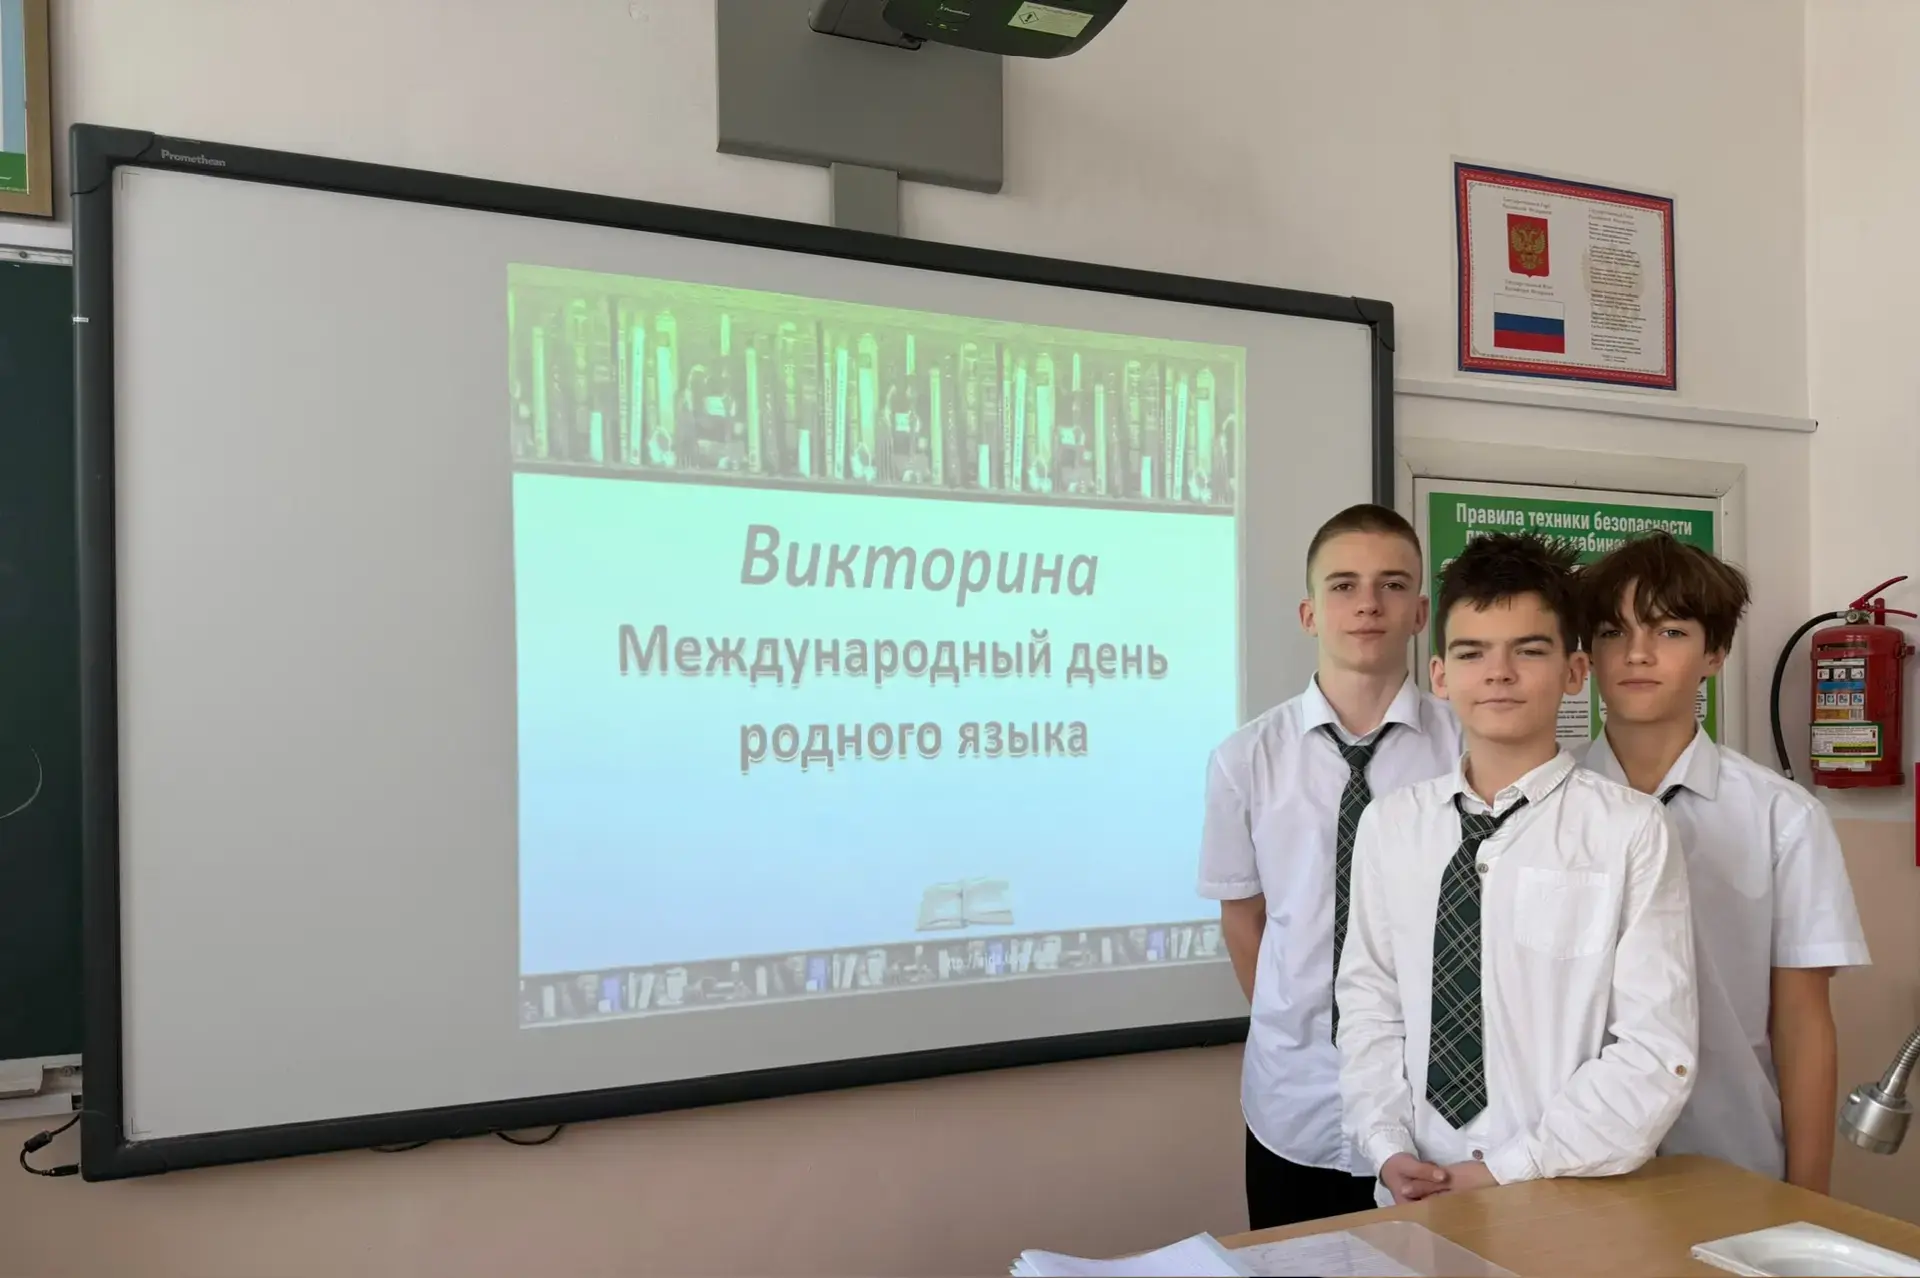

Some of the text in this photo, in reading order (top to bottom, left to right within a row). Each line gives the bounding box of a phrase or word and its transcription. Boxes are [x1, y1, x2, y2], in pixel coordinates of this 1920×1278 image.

[161, 148, 226, 167] Promethean
[1456, 502, 1692, 536] Правила техники безопасности
[740, 523, 1099, 608] Викторина
[617, 623, 1169, 687] Международный день
[740, 719, 1089, 773] родного языка
